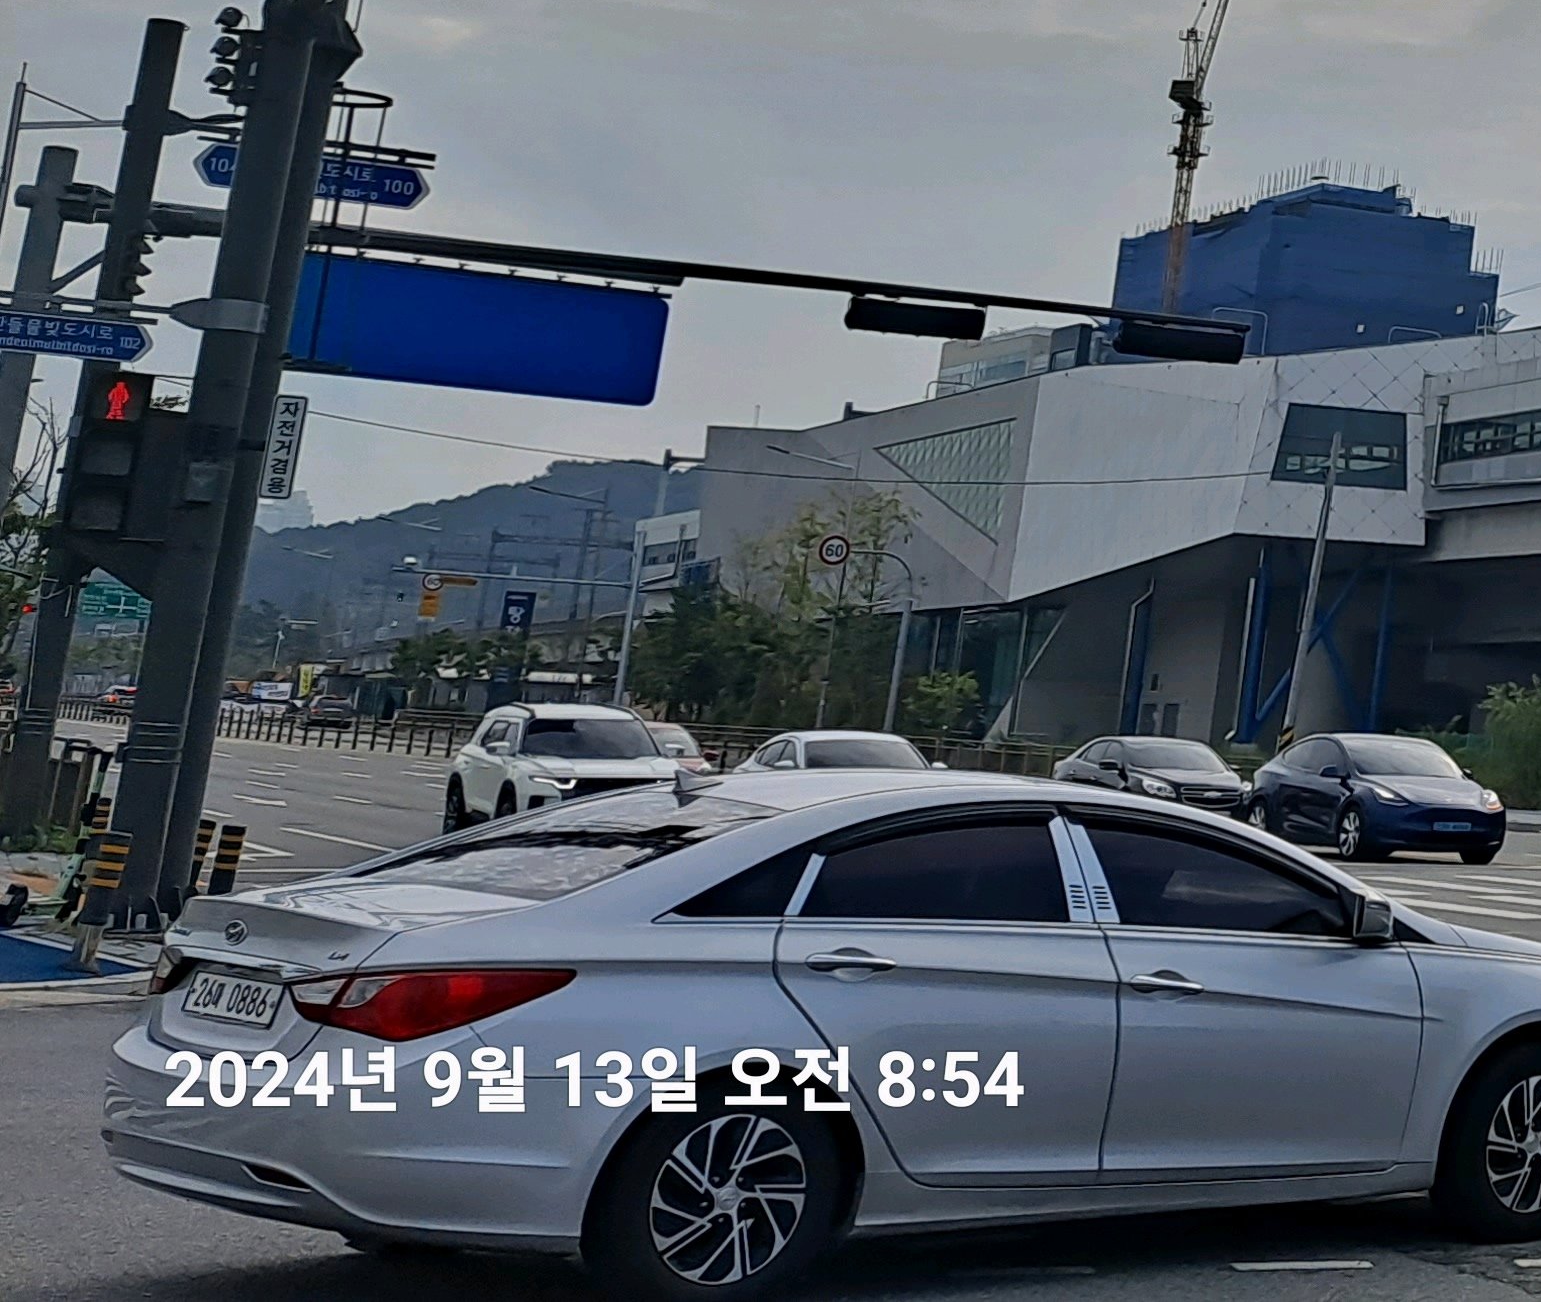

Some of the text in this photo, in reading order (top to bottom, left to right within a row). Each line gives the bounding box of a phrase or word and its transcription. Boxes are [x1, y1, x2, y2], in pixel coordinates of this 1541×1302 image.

[384, 179, 415, 196] 100
[267, 401, 300, 495] 자전거겸용
[825, 544, 844, 558] 60
[226, 982, 273, 1018] 0886
